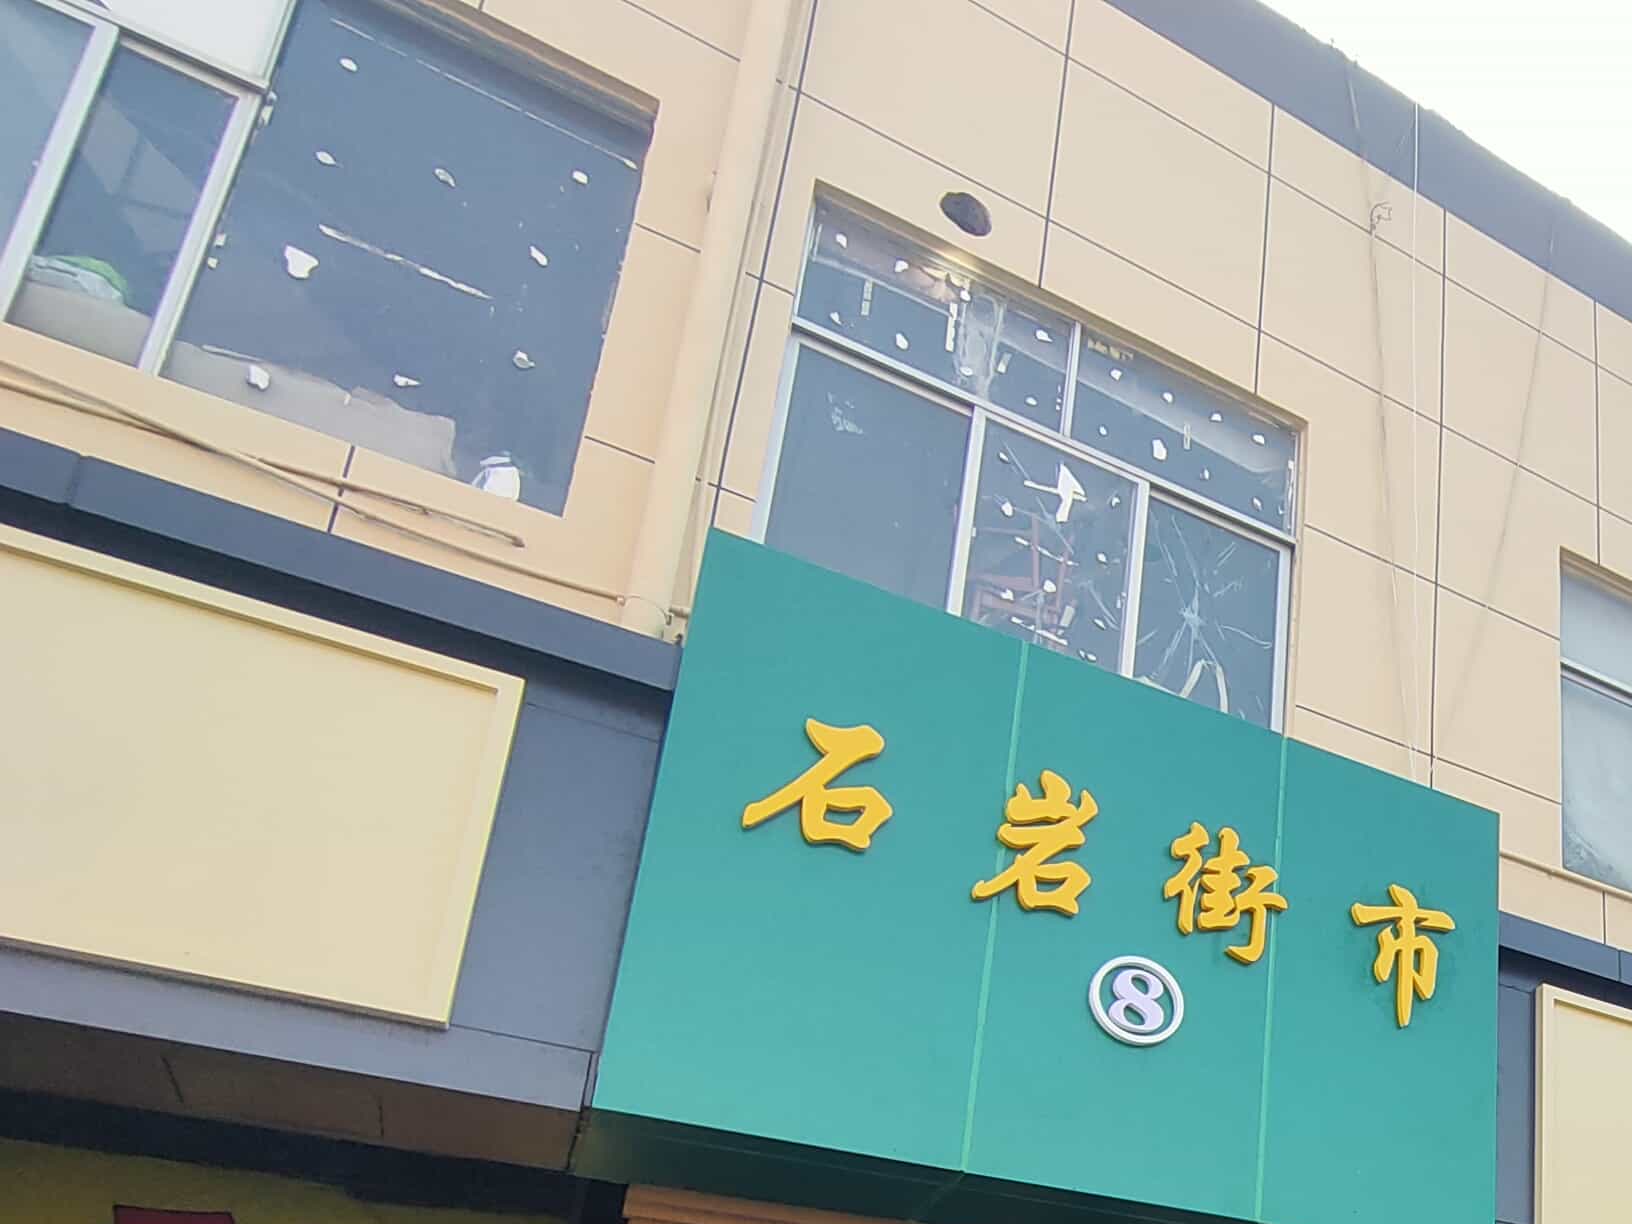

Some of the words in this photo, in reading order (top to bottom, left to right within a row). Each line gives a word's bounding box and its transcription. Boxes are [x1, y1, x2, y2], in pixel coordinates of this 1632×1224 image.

[742, 717, 1456, 1028] 石岩街市
[1104, 966, 1169, 1036] 8
